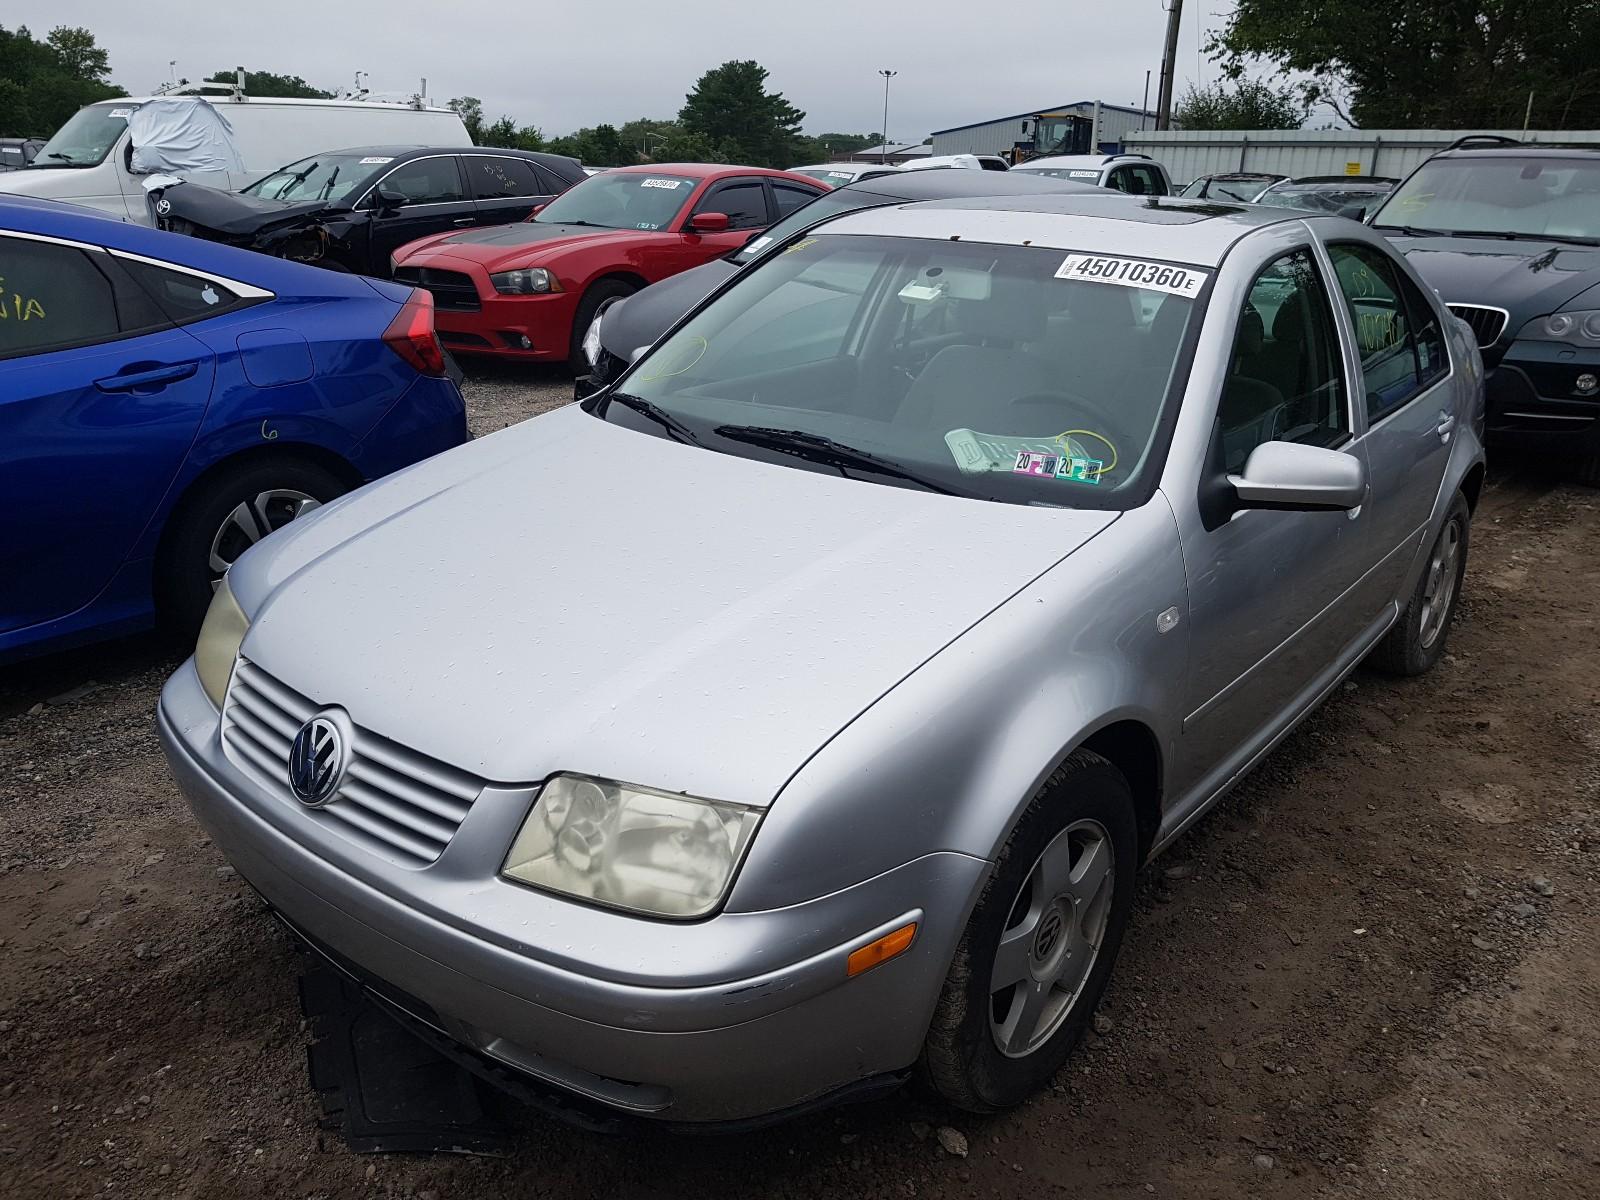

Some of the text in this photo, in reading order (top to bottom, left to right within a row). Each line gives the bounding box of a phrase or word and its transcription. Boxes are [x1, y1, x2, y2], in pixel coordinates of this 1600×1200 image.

[261, 419, 278, 440] 6
[1017, 453, 1030, 470] 20
[1045, 460, 1055, 474] 12
[1059, 458, 1073, 474] 20
